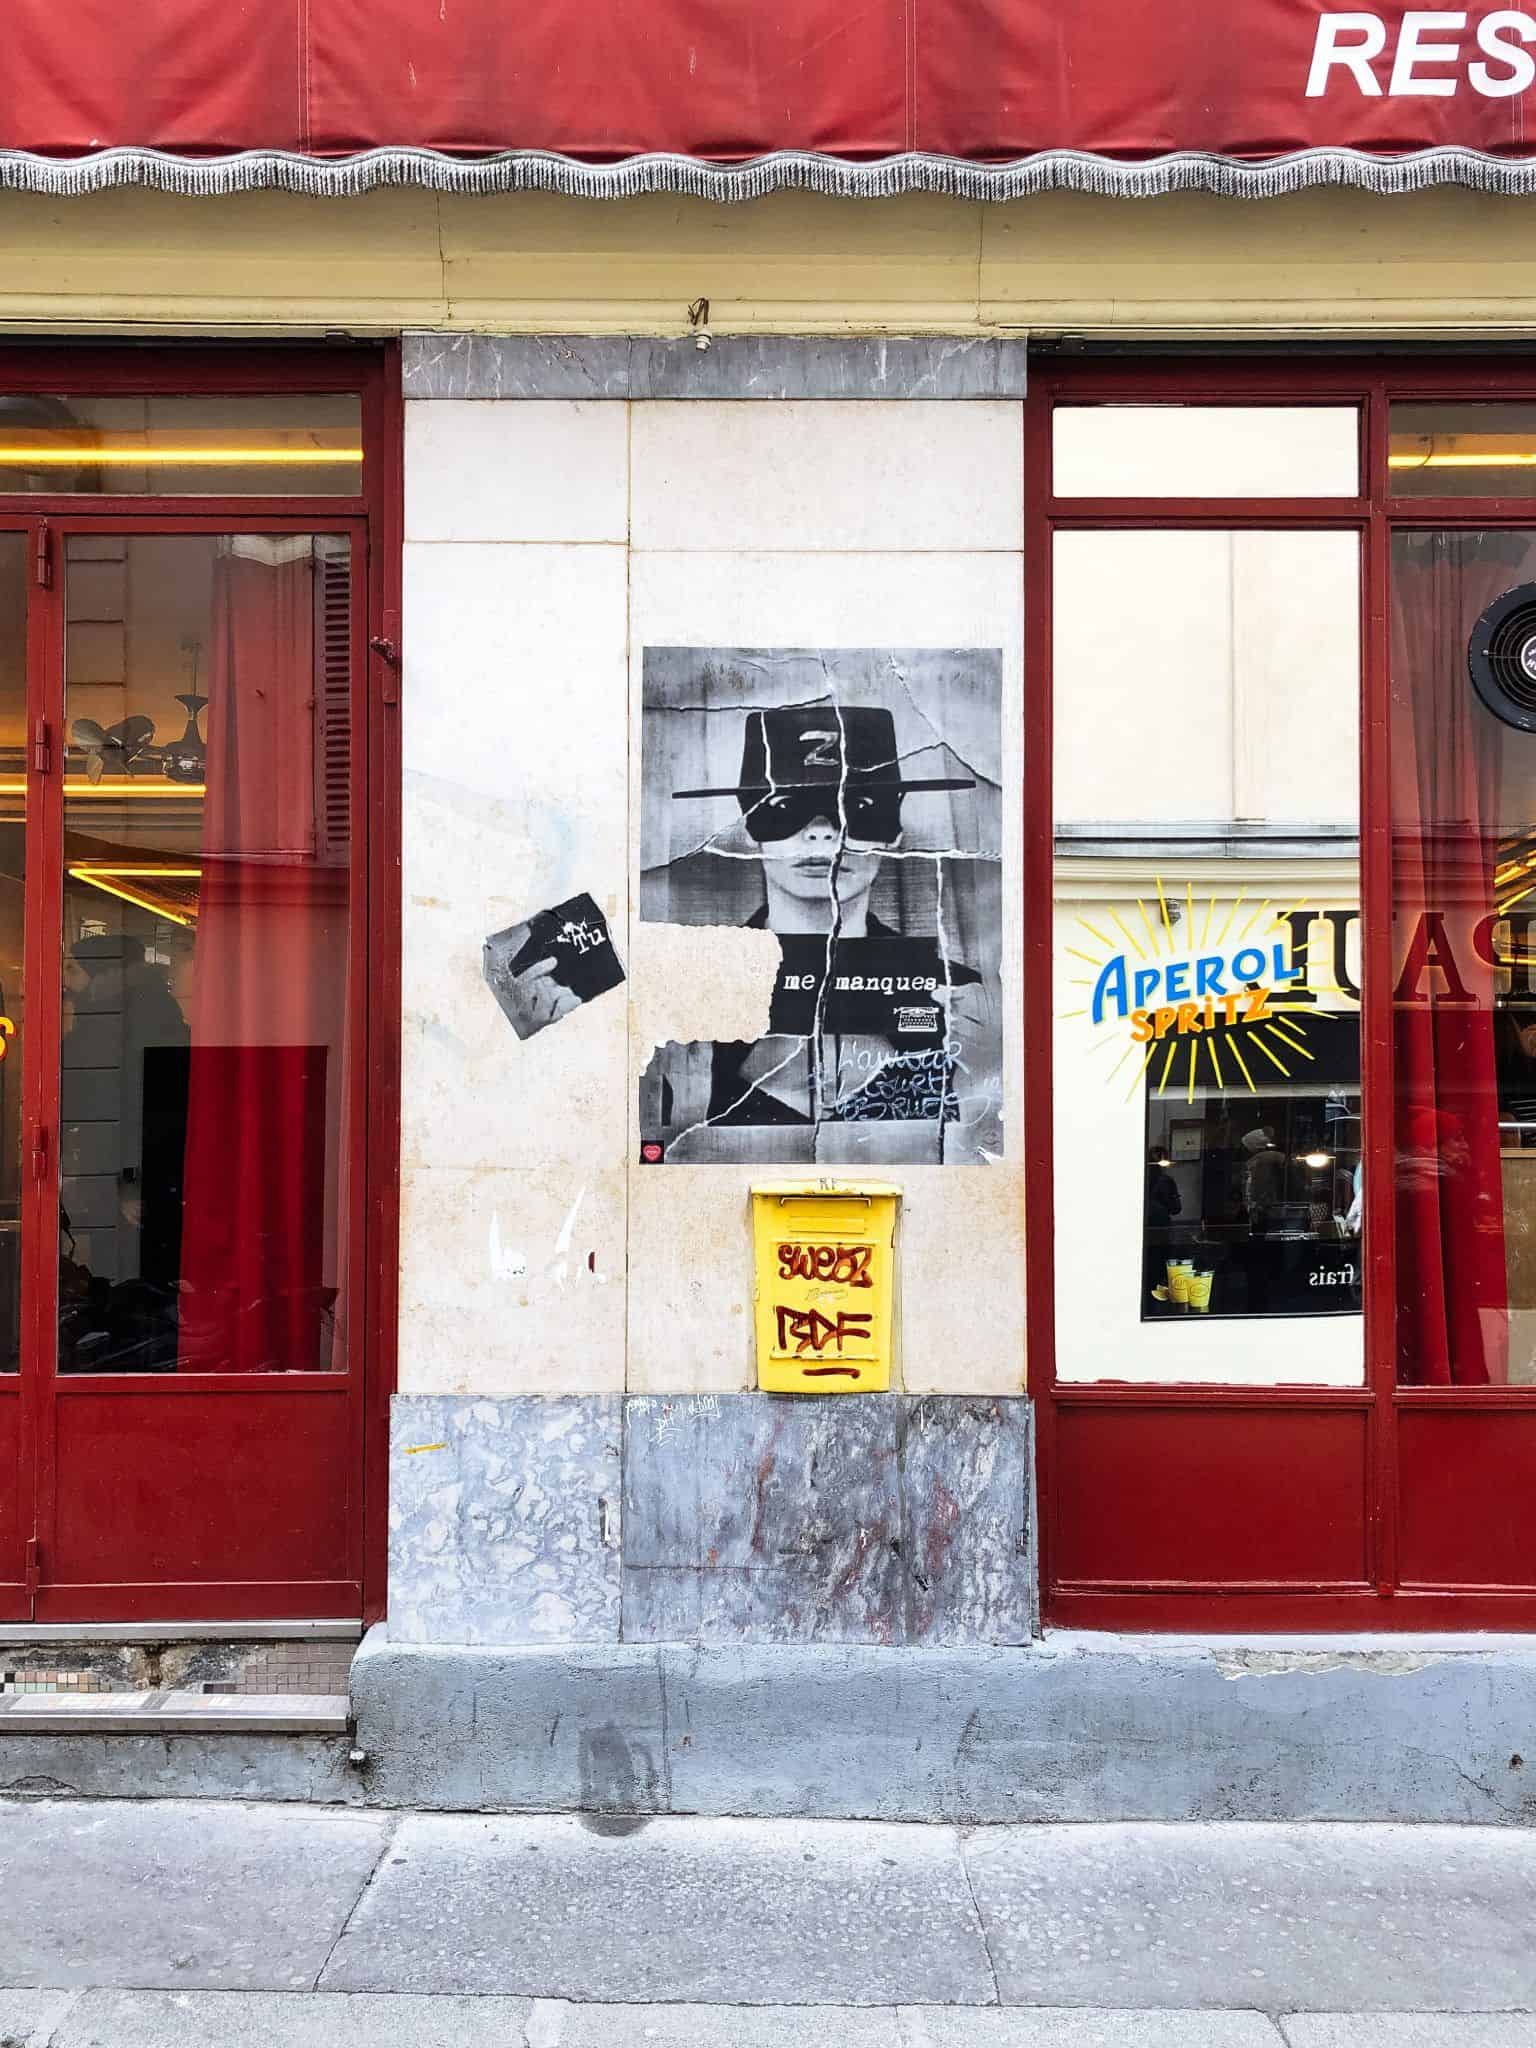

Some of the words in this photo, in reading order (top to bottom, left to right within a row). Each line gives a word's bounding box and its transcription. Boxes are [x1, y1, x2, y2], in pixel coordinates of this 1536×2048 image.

[1305, 10, 1536, 98] RES
[799, 730, 839, 766] Z
[784, 974, 816, 990] me
[835, 975, 937, 996] manques
[1092, 943, 1300, 1024] APEROL
